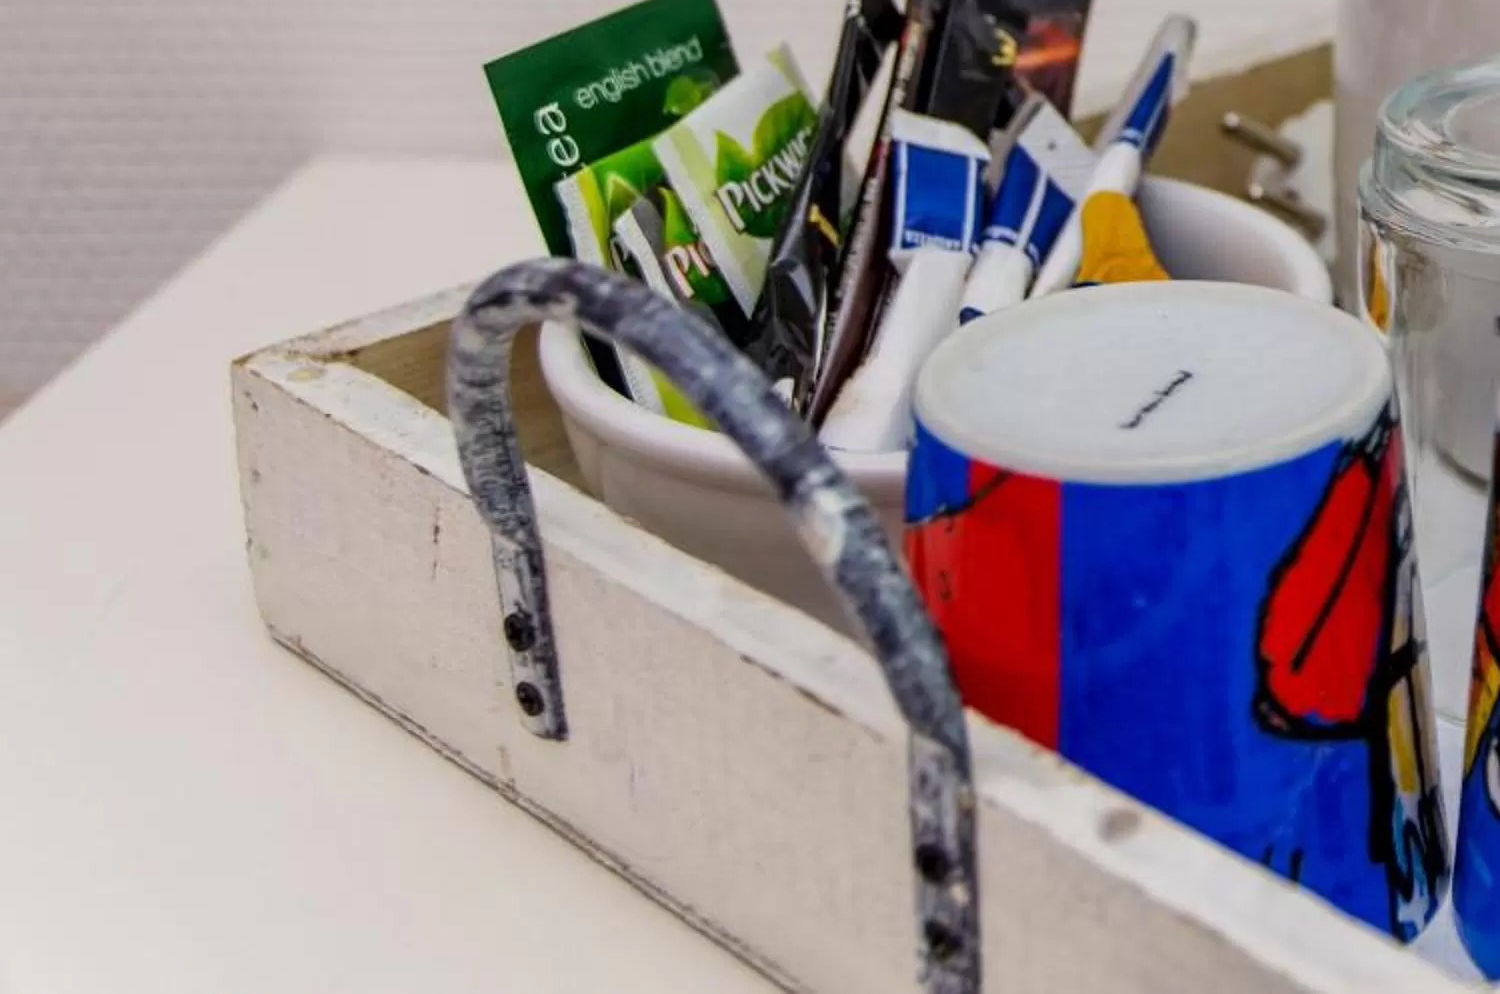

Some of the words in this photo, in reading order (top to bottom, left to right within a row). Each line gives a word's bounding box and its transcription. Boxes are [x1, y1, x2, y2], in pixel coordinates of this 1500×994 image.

[574, 60, 652, 109] english
[643, 34, 704, 78] blend
[534, 101, 586, 178] ea
[714, 126, 813, 234] PICKWI
